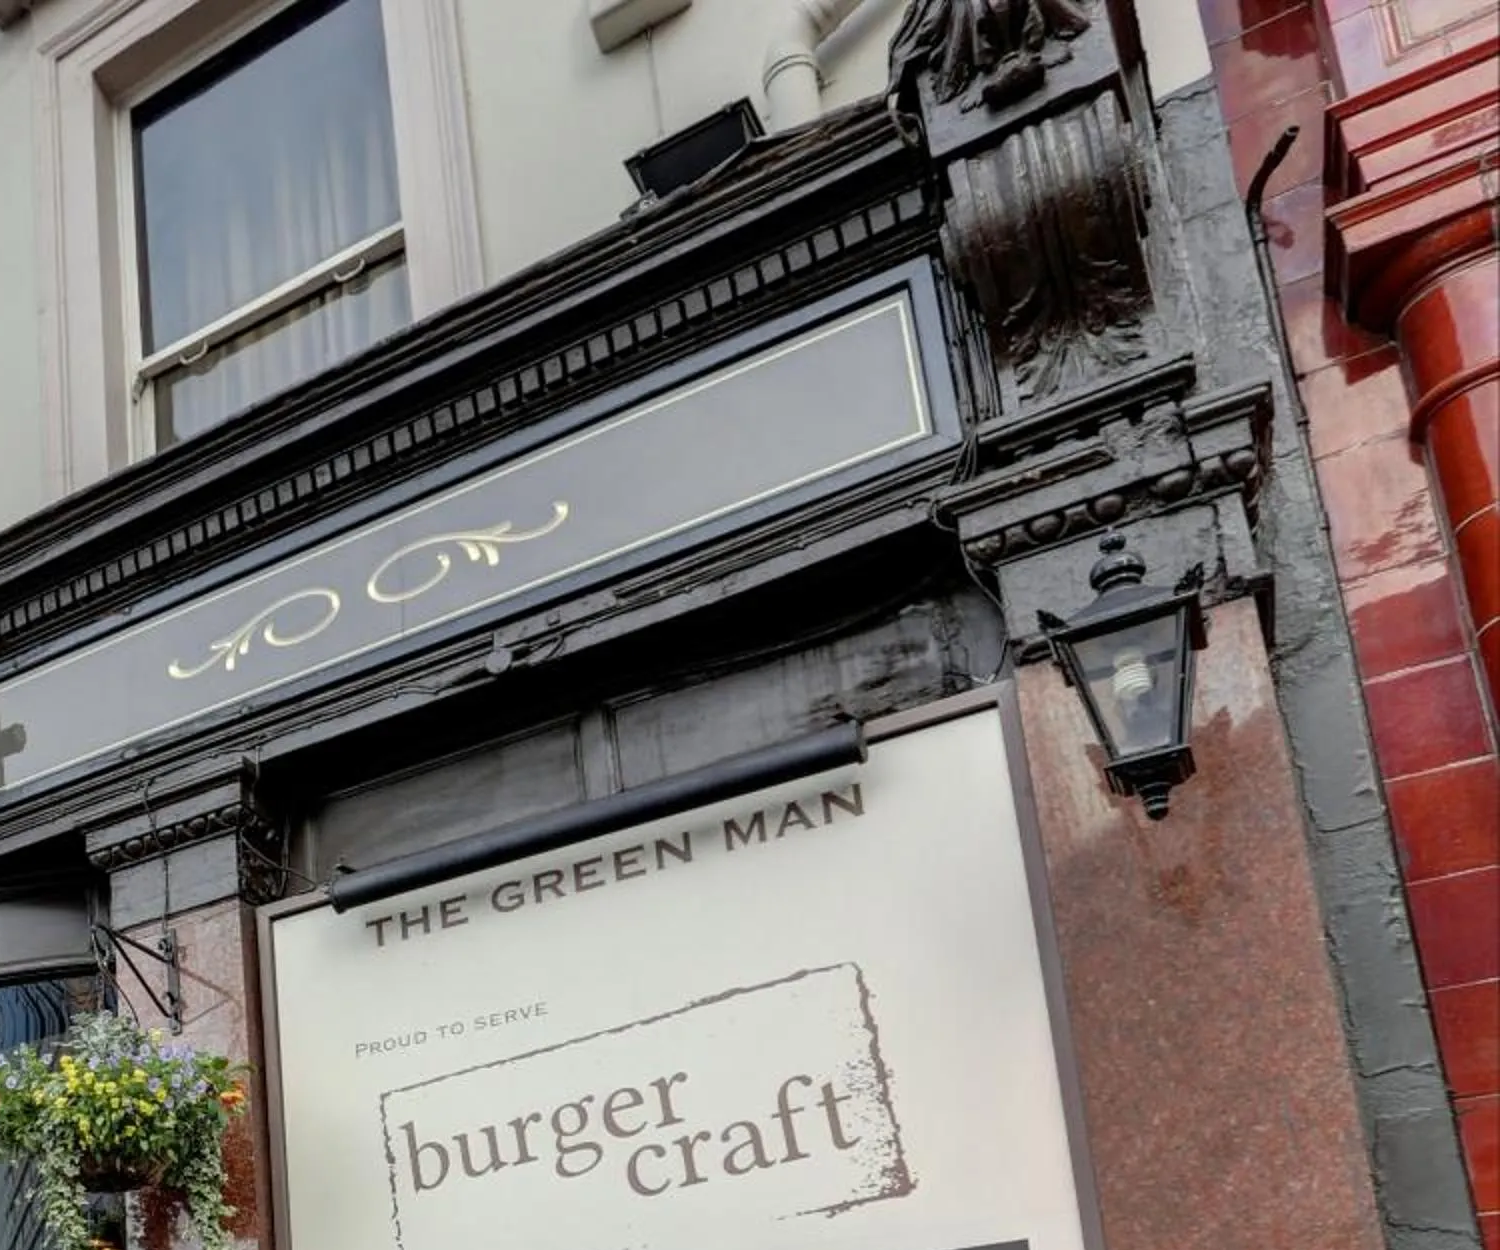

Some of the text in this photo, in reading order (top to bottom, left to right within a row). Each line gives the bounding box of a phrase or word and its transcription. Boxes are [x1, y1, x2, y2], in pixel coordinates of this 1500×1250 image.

[366, 783, 867, 948] THE GREEN MAN
[355, 1002, 549, 1059] PROUD TO SERVE
[401, 1071, 689, 1194] burger
[627, 1075, 861, 1197] craft
